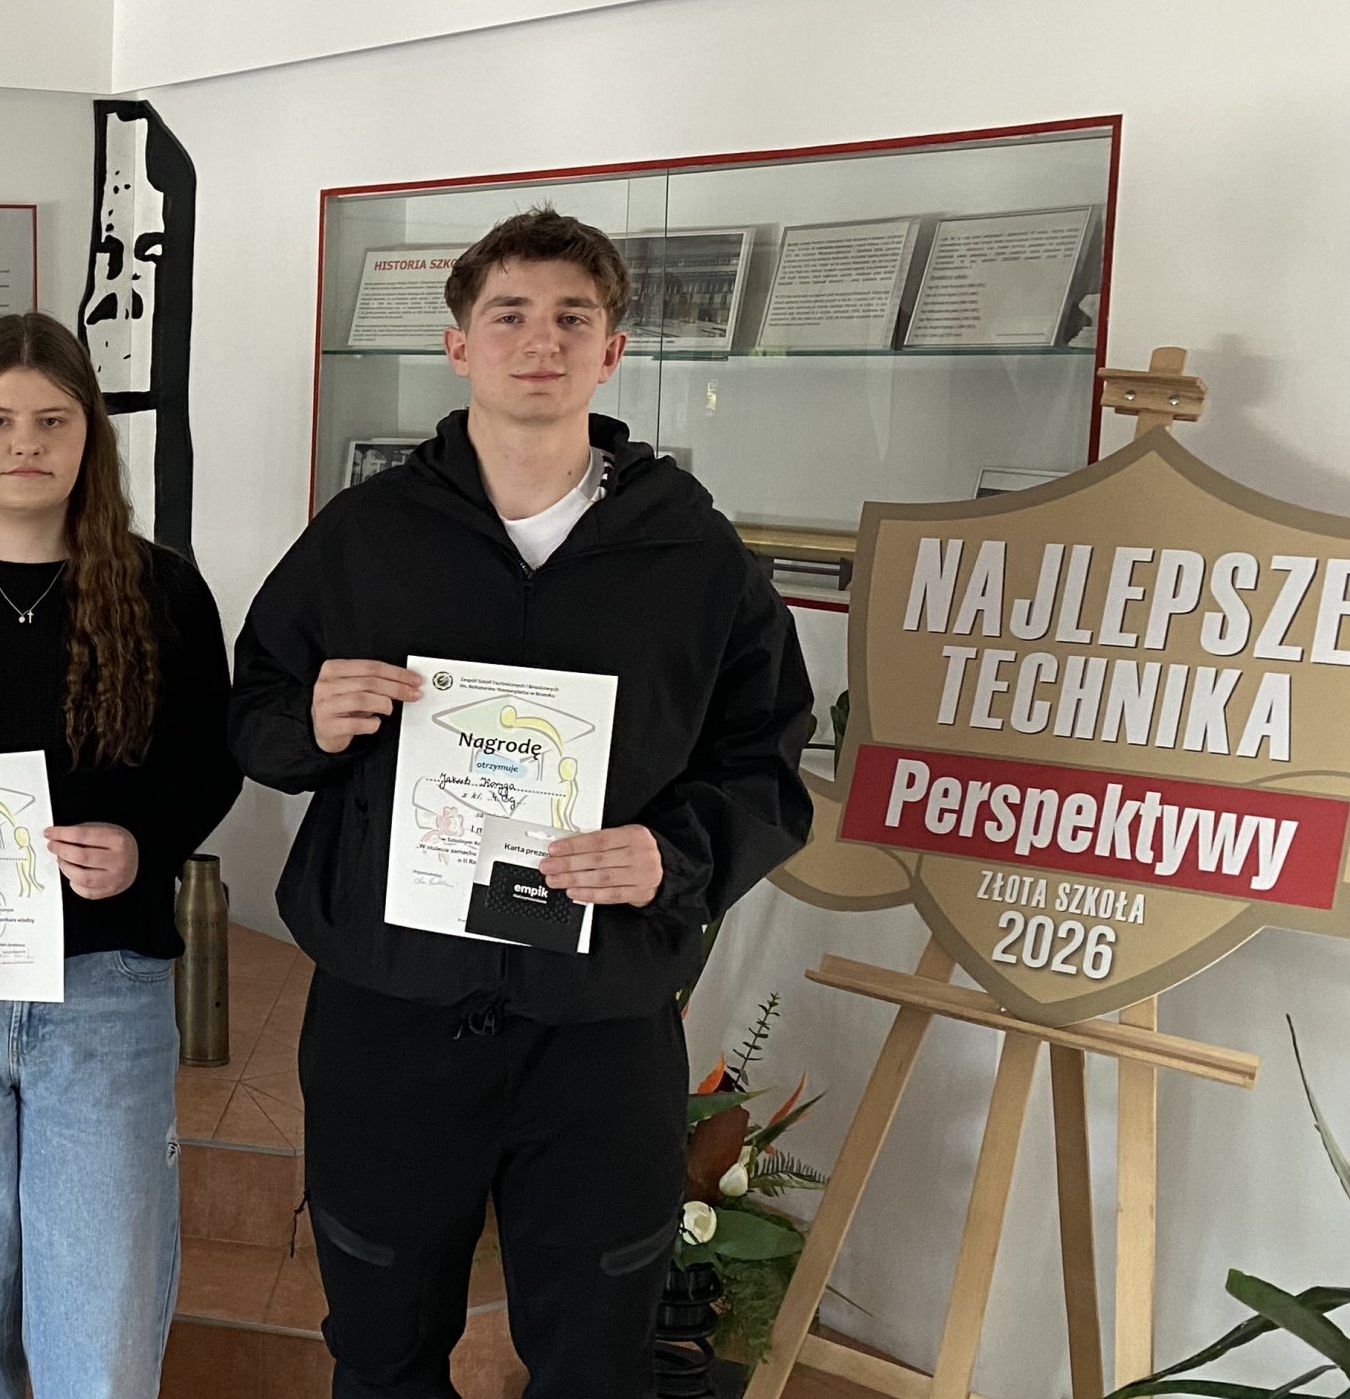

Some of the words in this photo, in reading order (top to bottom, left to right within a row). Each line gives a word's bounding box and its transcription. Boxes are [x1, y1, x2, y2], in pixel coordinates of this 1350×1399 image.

[374, 260, 426, 271] HISTORIA
[902, 536, 1350, 666] NAJLEPSZE
[936, 645, 1292, 762] TECHNIKA
[458, 732, 542, 760] Nagrodę
[476, 761, 518, 773] otrzymuje
[884, 758, 1299, 891] Perspektywy
[504, 843, 525, 853] Karta
[513, 884, 548, 898] empik
[976, 870, 1047, 909] ZŁOTA
[1055, 882, 1145, 924] SZKOŁA
[991, 910, 1118, 980] 2026
